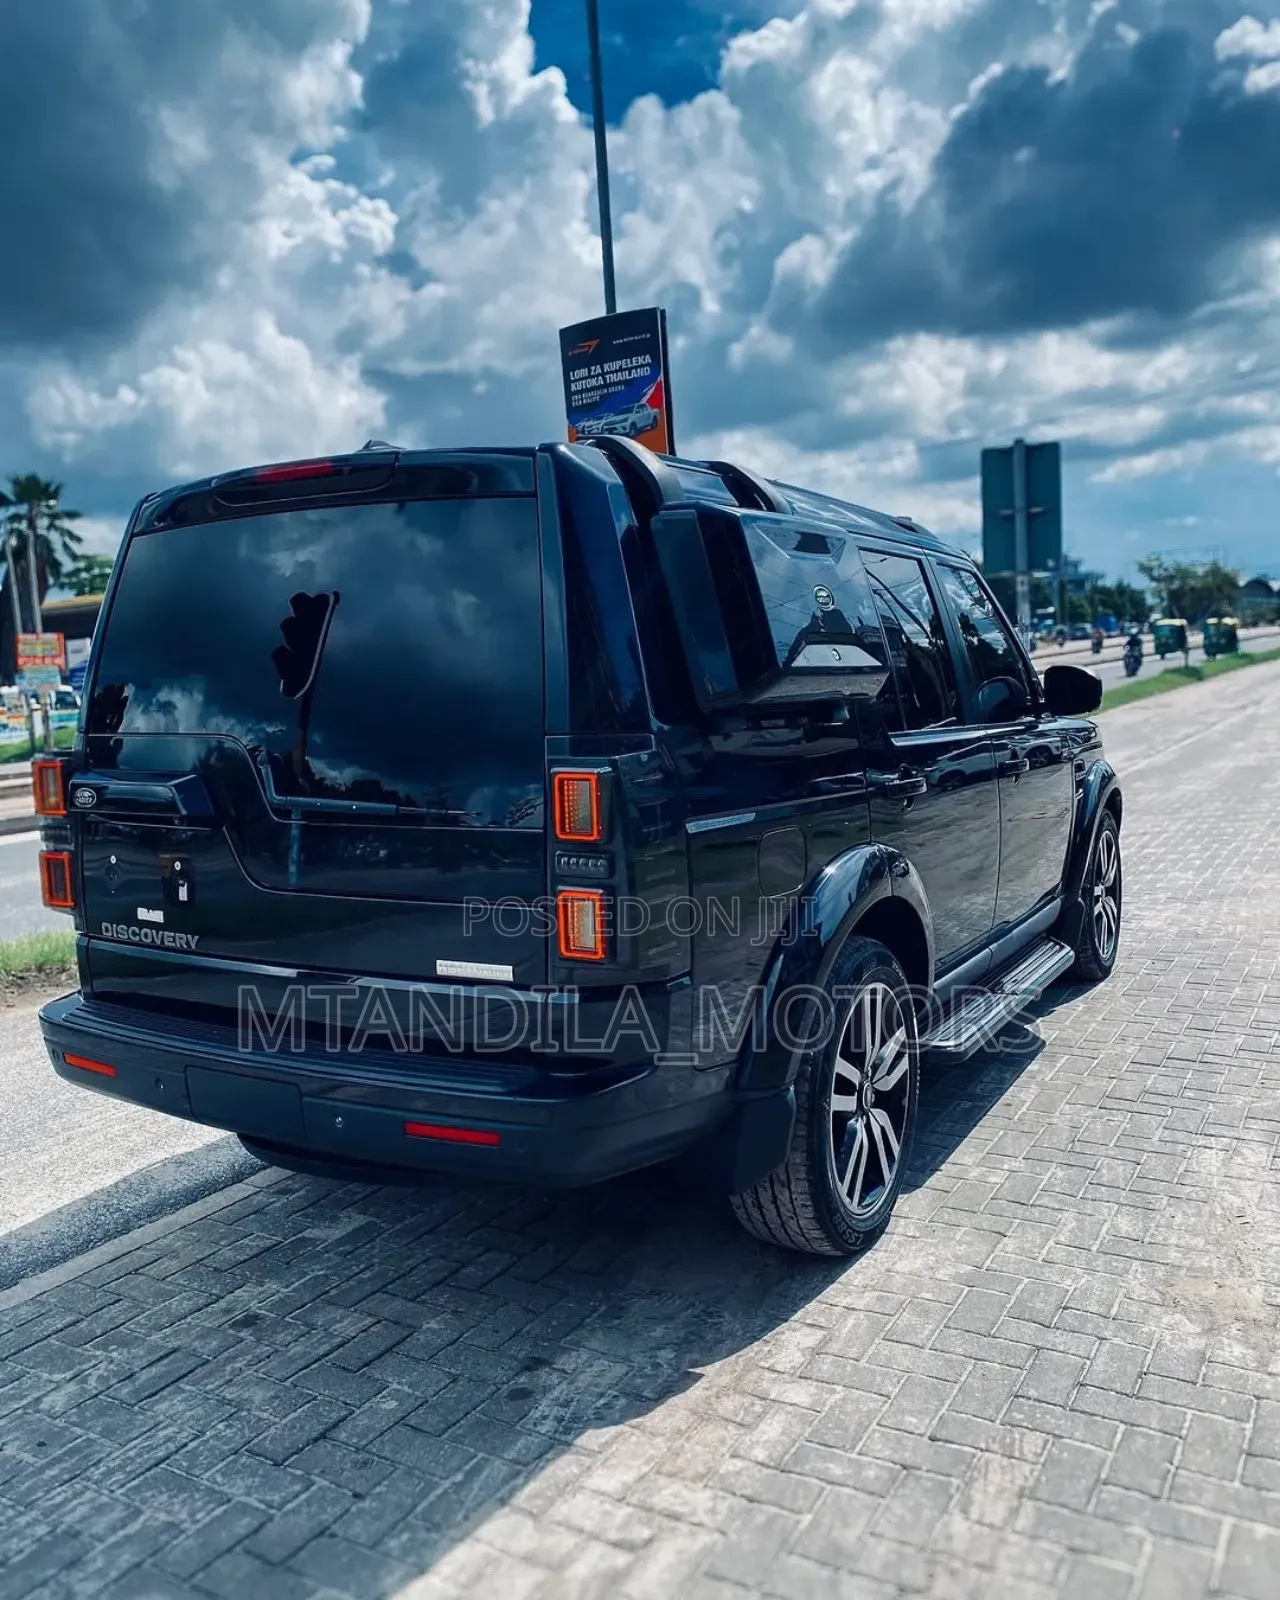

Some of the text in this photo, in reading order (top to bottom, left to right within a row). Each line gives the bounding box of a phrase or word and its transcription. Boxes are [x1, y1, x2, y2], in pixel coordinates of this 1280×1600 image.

[590, 364, 602, 376] ZA
[604, 354, 652, 372] KUPELEKA
[571, 377, 604, 392] KUTOKA
[605, 366, 651, 384] THAILAND
[101, 922, 200, 949] DISCOVERY
